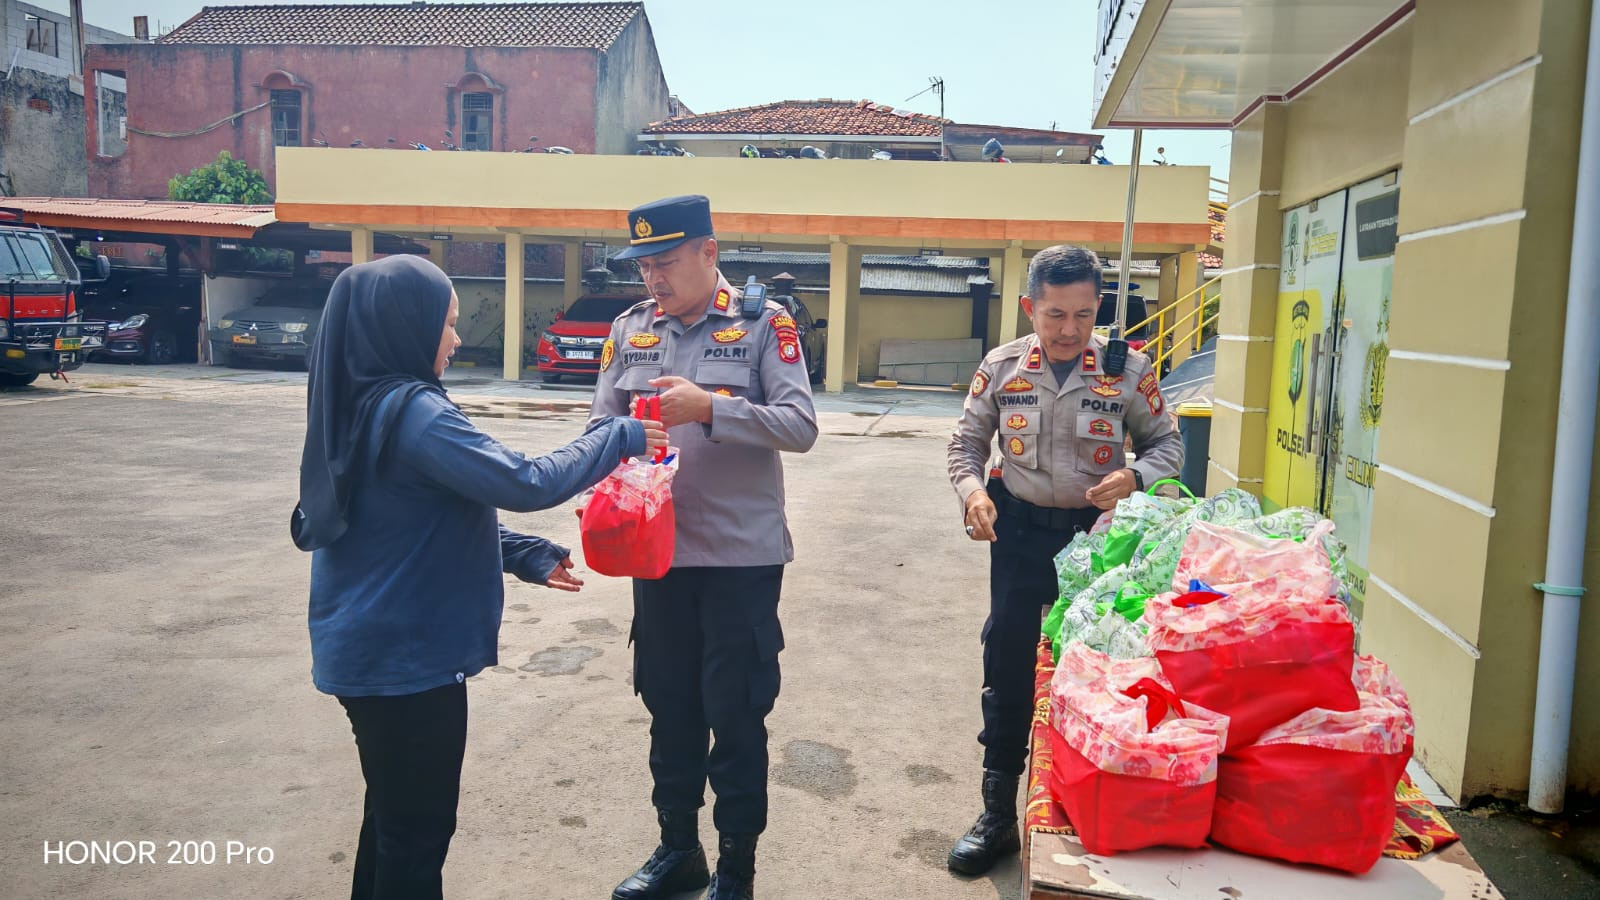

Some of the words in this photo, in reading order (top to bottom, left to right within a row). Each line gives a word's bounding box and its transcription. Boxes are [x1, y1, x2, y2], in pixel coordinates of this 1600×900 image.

[623, 350, 660, 365] SYUAIB
[703, 346, 747, 359] POLRI
[1081, 398, 1124, 413] POLRI
